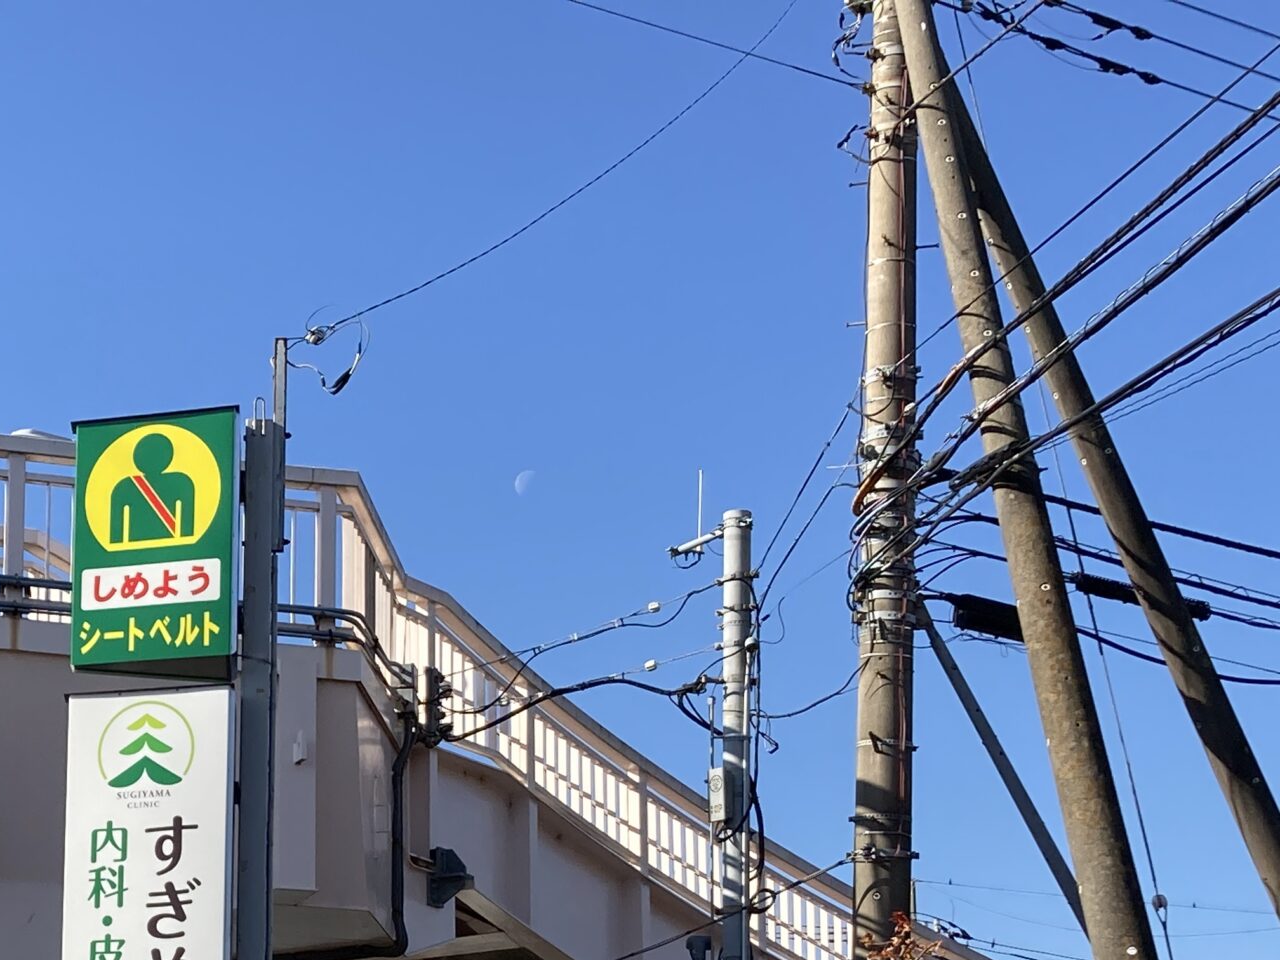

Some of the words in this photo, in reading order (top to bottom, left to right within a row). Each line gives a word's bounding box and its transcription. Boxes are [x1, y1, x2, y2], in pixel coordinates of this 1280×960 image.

[93, 565, 210, 602] しめよう
[80, 611, 220, 654] シートベルト
[116, 789, 171, 800] SUGIYAMA
[127, 801, 160, 809] CLINIC
